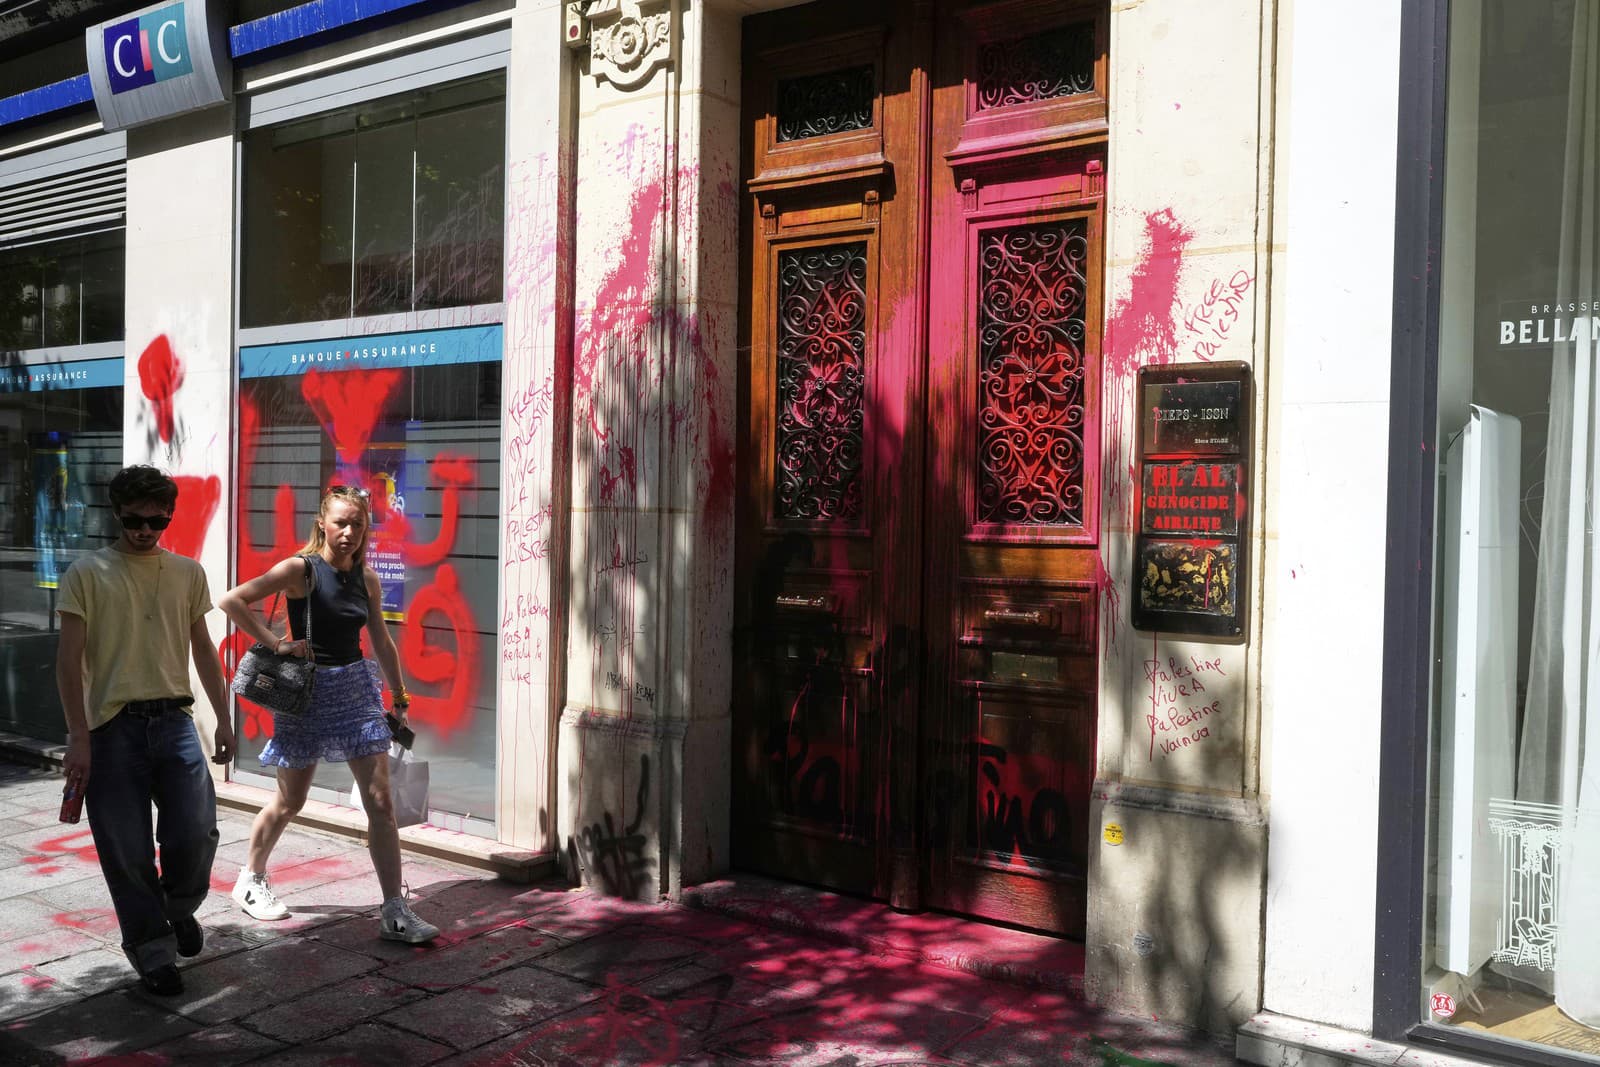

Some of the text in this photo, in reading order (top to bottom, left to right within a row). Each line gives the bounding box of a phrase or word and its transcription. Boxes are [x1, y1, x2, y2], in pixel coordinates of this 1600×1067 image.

[113, 20, 181, 78] CIC
[292, 343, 436, 363] BANQUE ASSURANCE
[35, 370, 87, 382] ASSURANCE
[1201, 407, 1229, 420] ISSN
[1152, 465, 1226, 488] EL AL
[1147, 495, 1229, 510] GENOCIDE
[1153, 515, 1221, 531] AIRLINE
[1146, 701, 1221, 735] Palestine
